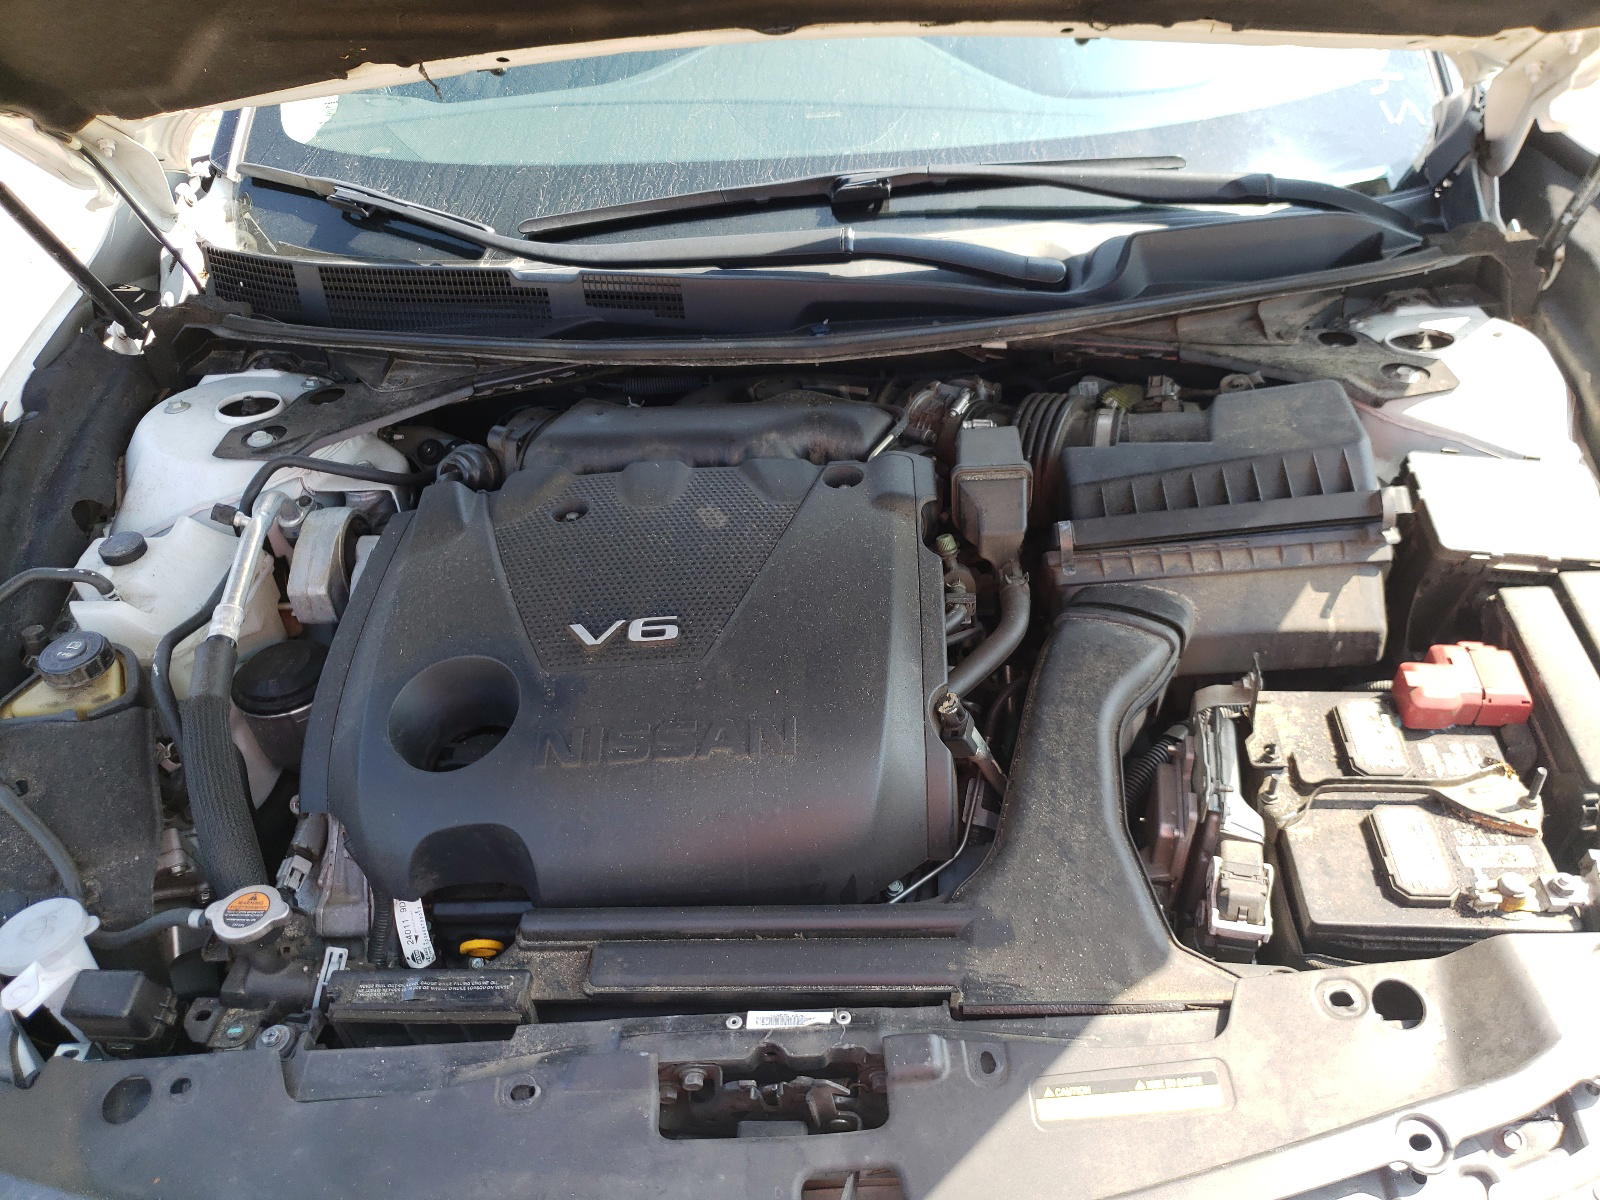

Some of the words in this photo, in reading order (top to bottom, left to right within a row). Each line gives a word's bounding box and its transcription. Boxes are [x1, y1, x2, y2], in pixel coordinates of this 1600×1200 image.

[569, 615, 679, 645] V6
[533, 717, 798, 769] NISSAN
[401, 919, 415, 945] 24011
